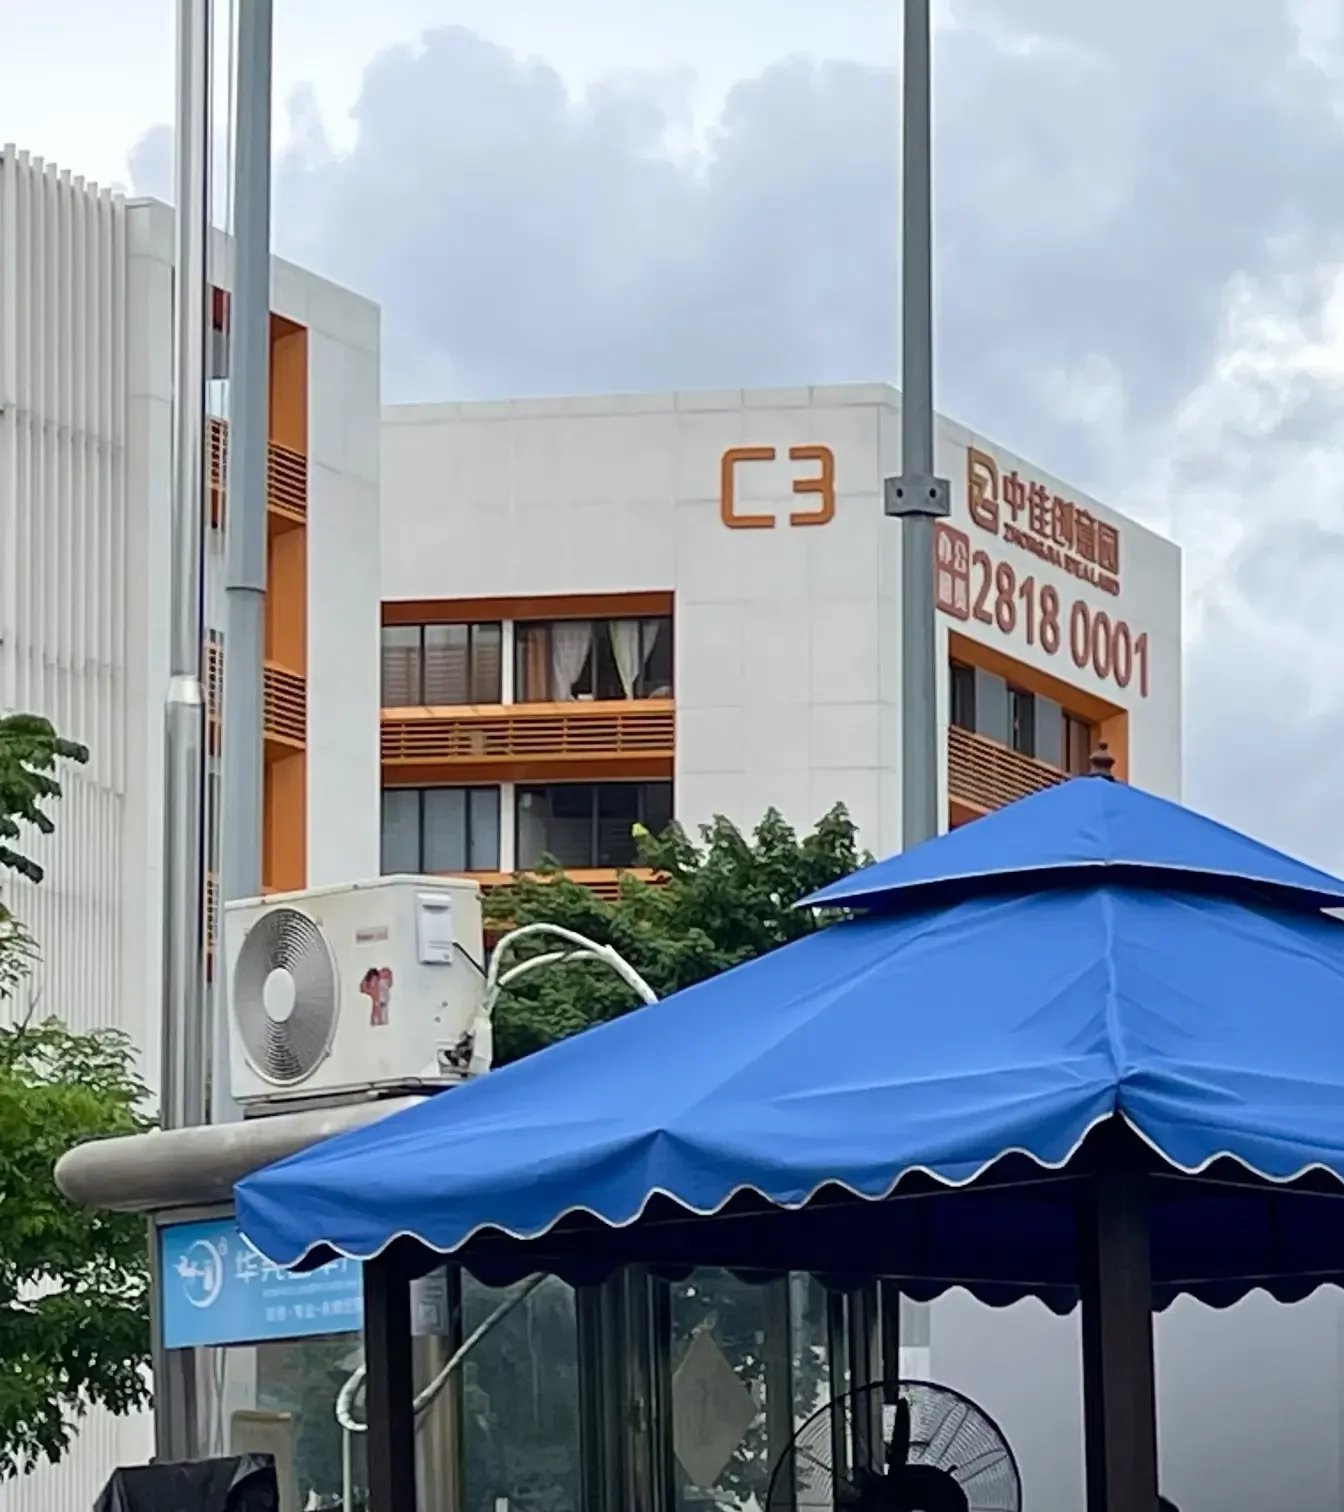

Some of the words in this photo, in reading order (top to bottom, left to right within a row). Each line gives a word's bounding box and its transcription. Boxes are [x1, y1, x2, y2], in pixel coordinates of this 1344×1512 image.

[721, 446, 835, 530] C3
[972, 551, 1060, 656] 2818
[1069, 600, 1149, 698] 0001
